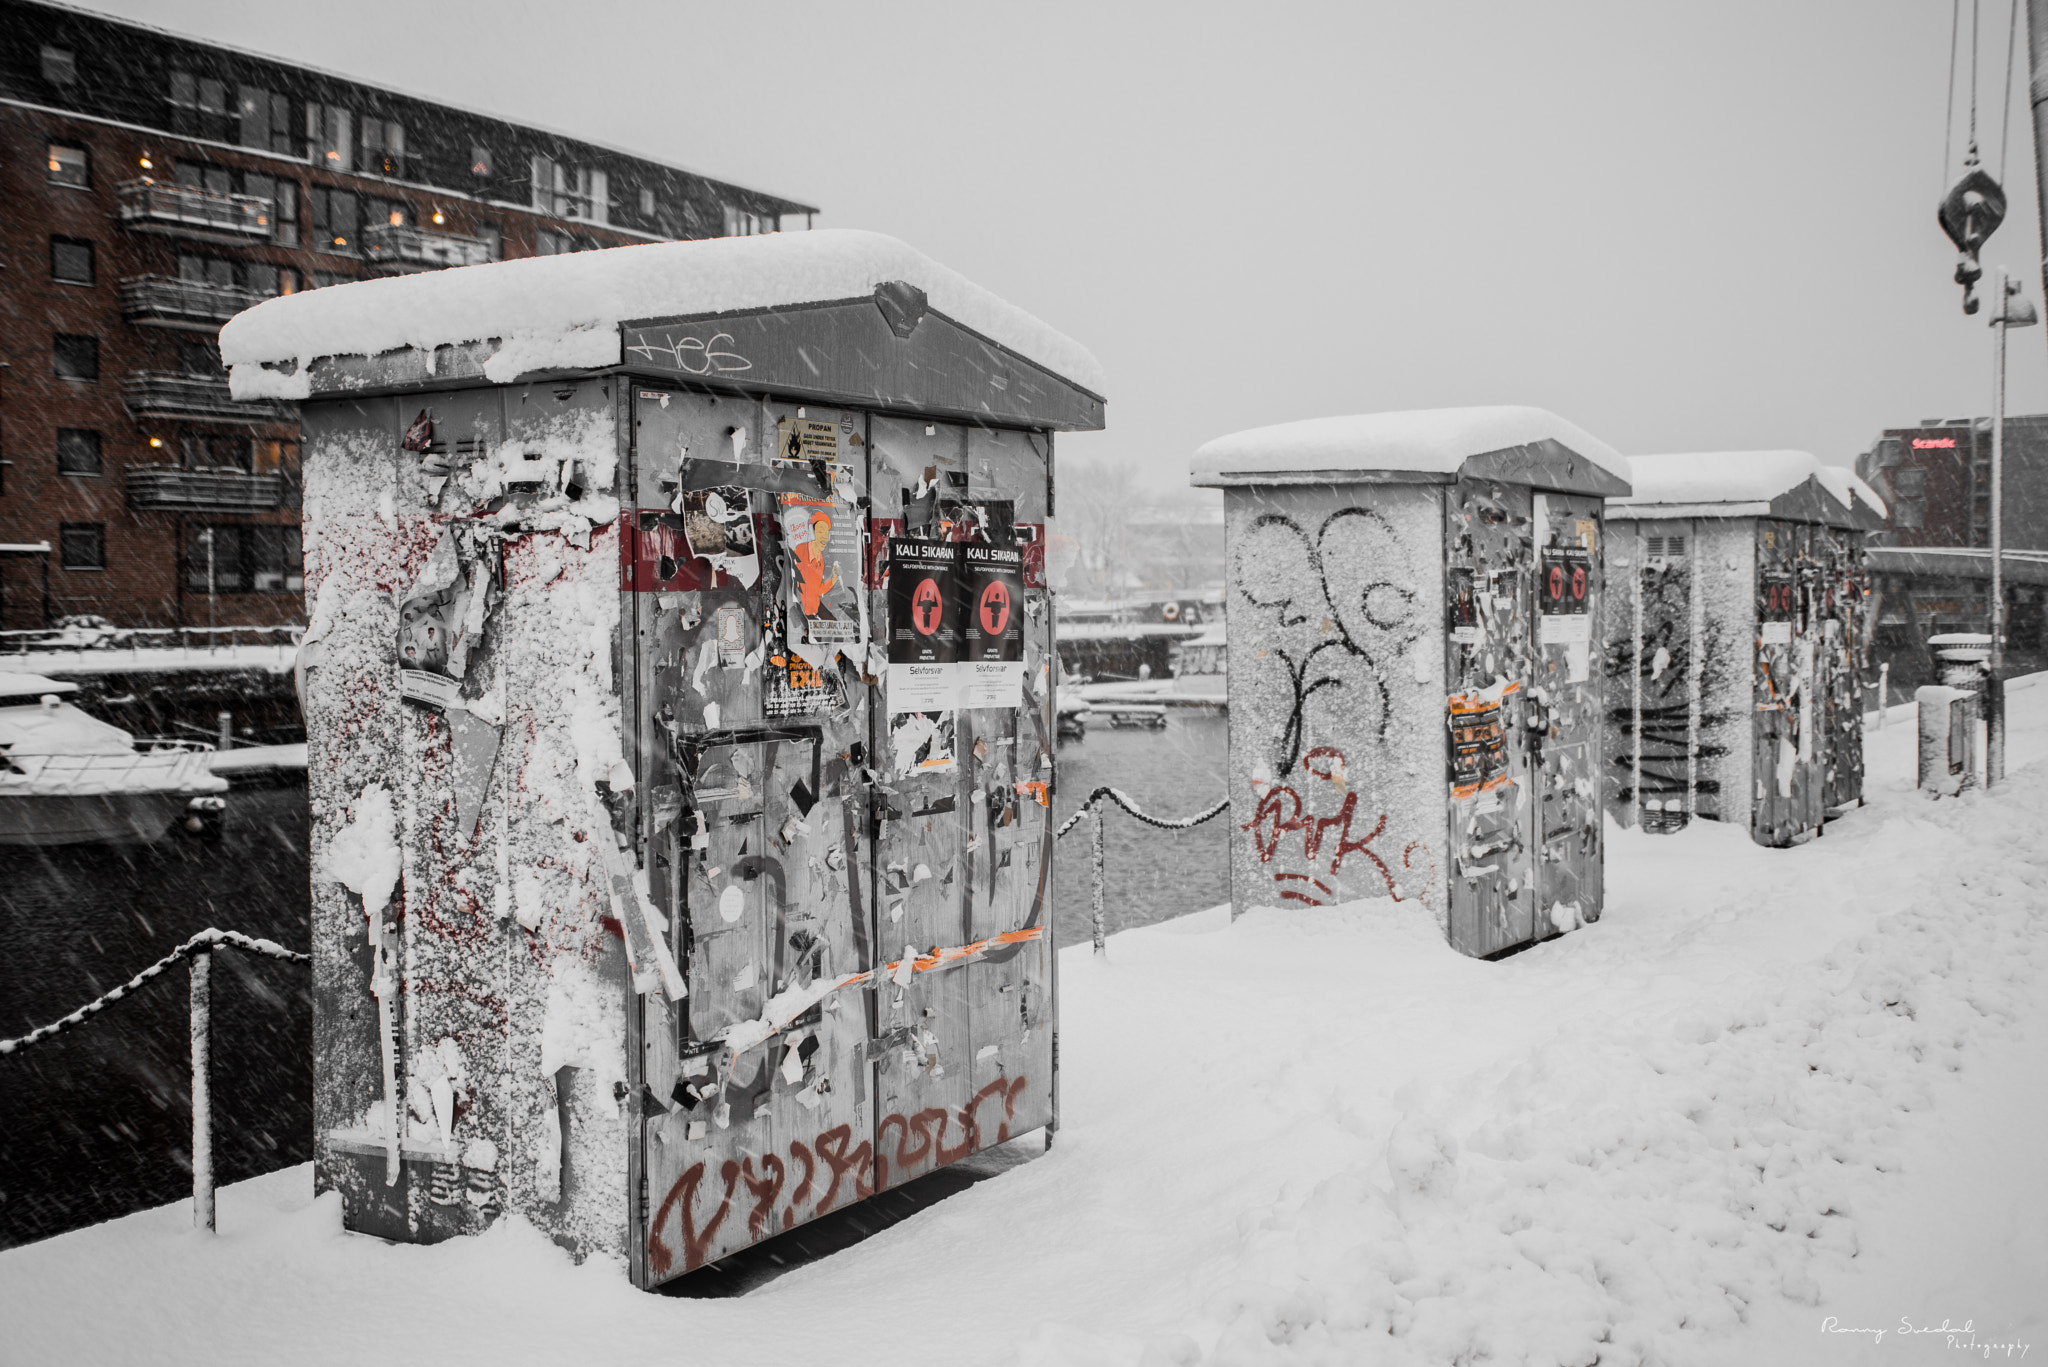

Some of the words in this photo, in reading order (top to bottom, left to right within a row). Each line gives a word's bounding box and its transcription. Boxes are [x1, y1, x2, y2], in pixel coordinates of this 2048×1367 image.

[808, 423, 832, 433] PROPAN
[1912, 437, 1956, 450] Scandic
[895, 544, 919, 556] KALI
[921, 545, 954, 559] SIKARAN
[967, 547, 988, 560] KALI
[990, 549, 1019, 562] SIKARAN
[909, 666, 943, 675] Selvforsvar
[975, 664, 1007, 673] Selvforsvar
[790, 669, 822, 688] EXIL
